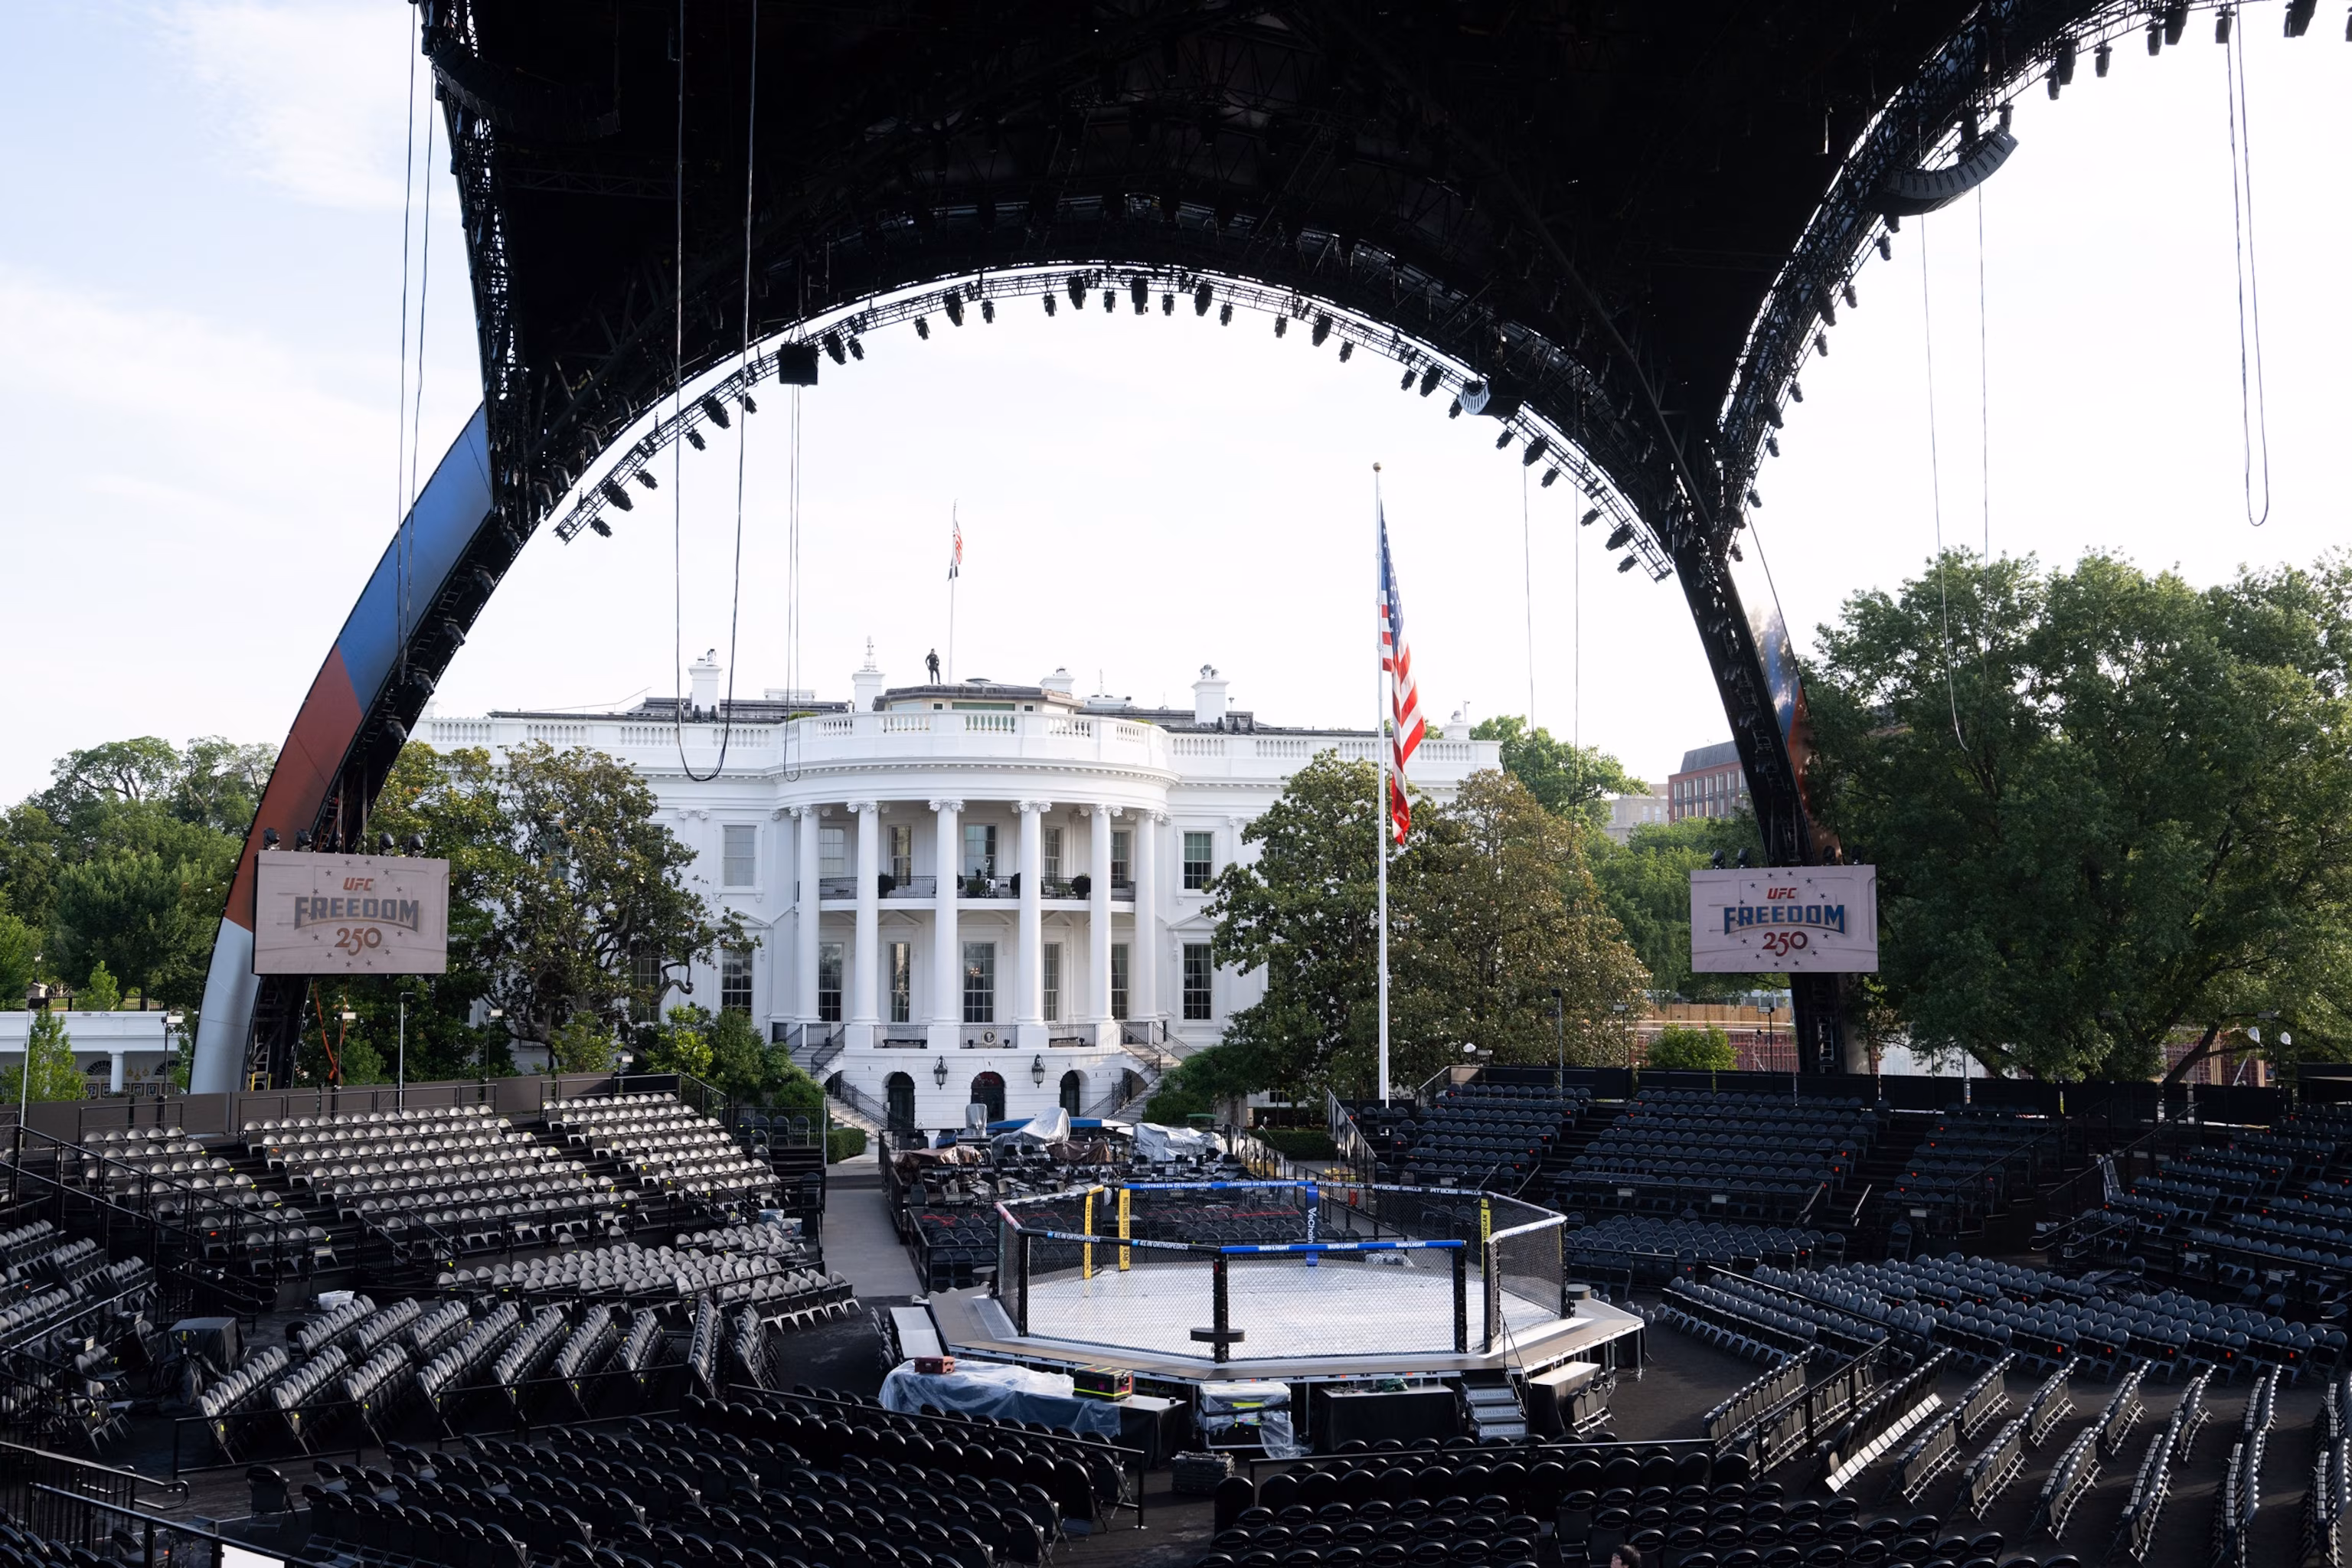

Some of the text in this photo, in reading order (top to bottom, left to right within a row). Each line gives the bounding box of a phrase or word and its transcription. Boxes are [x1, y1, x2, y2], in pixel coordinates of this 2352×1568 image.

[343, 877, 374, 891] UFC
[1767, 887, 1798, 900] UFC
[294, 896, 420, 933] FREEDOM
[1723, 904, 1845, 936] FREEDOM
[335, 927, 382, 956] 250
[1762, 931, 1808, 957] 250
[1067, 1233, 1101, 1243] ORTHOPEDICS
[1308, 1207, 1317, 1243] VeChain
[1152, 1241, 1189, 1250] ORTHOPEDICS
